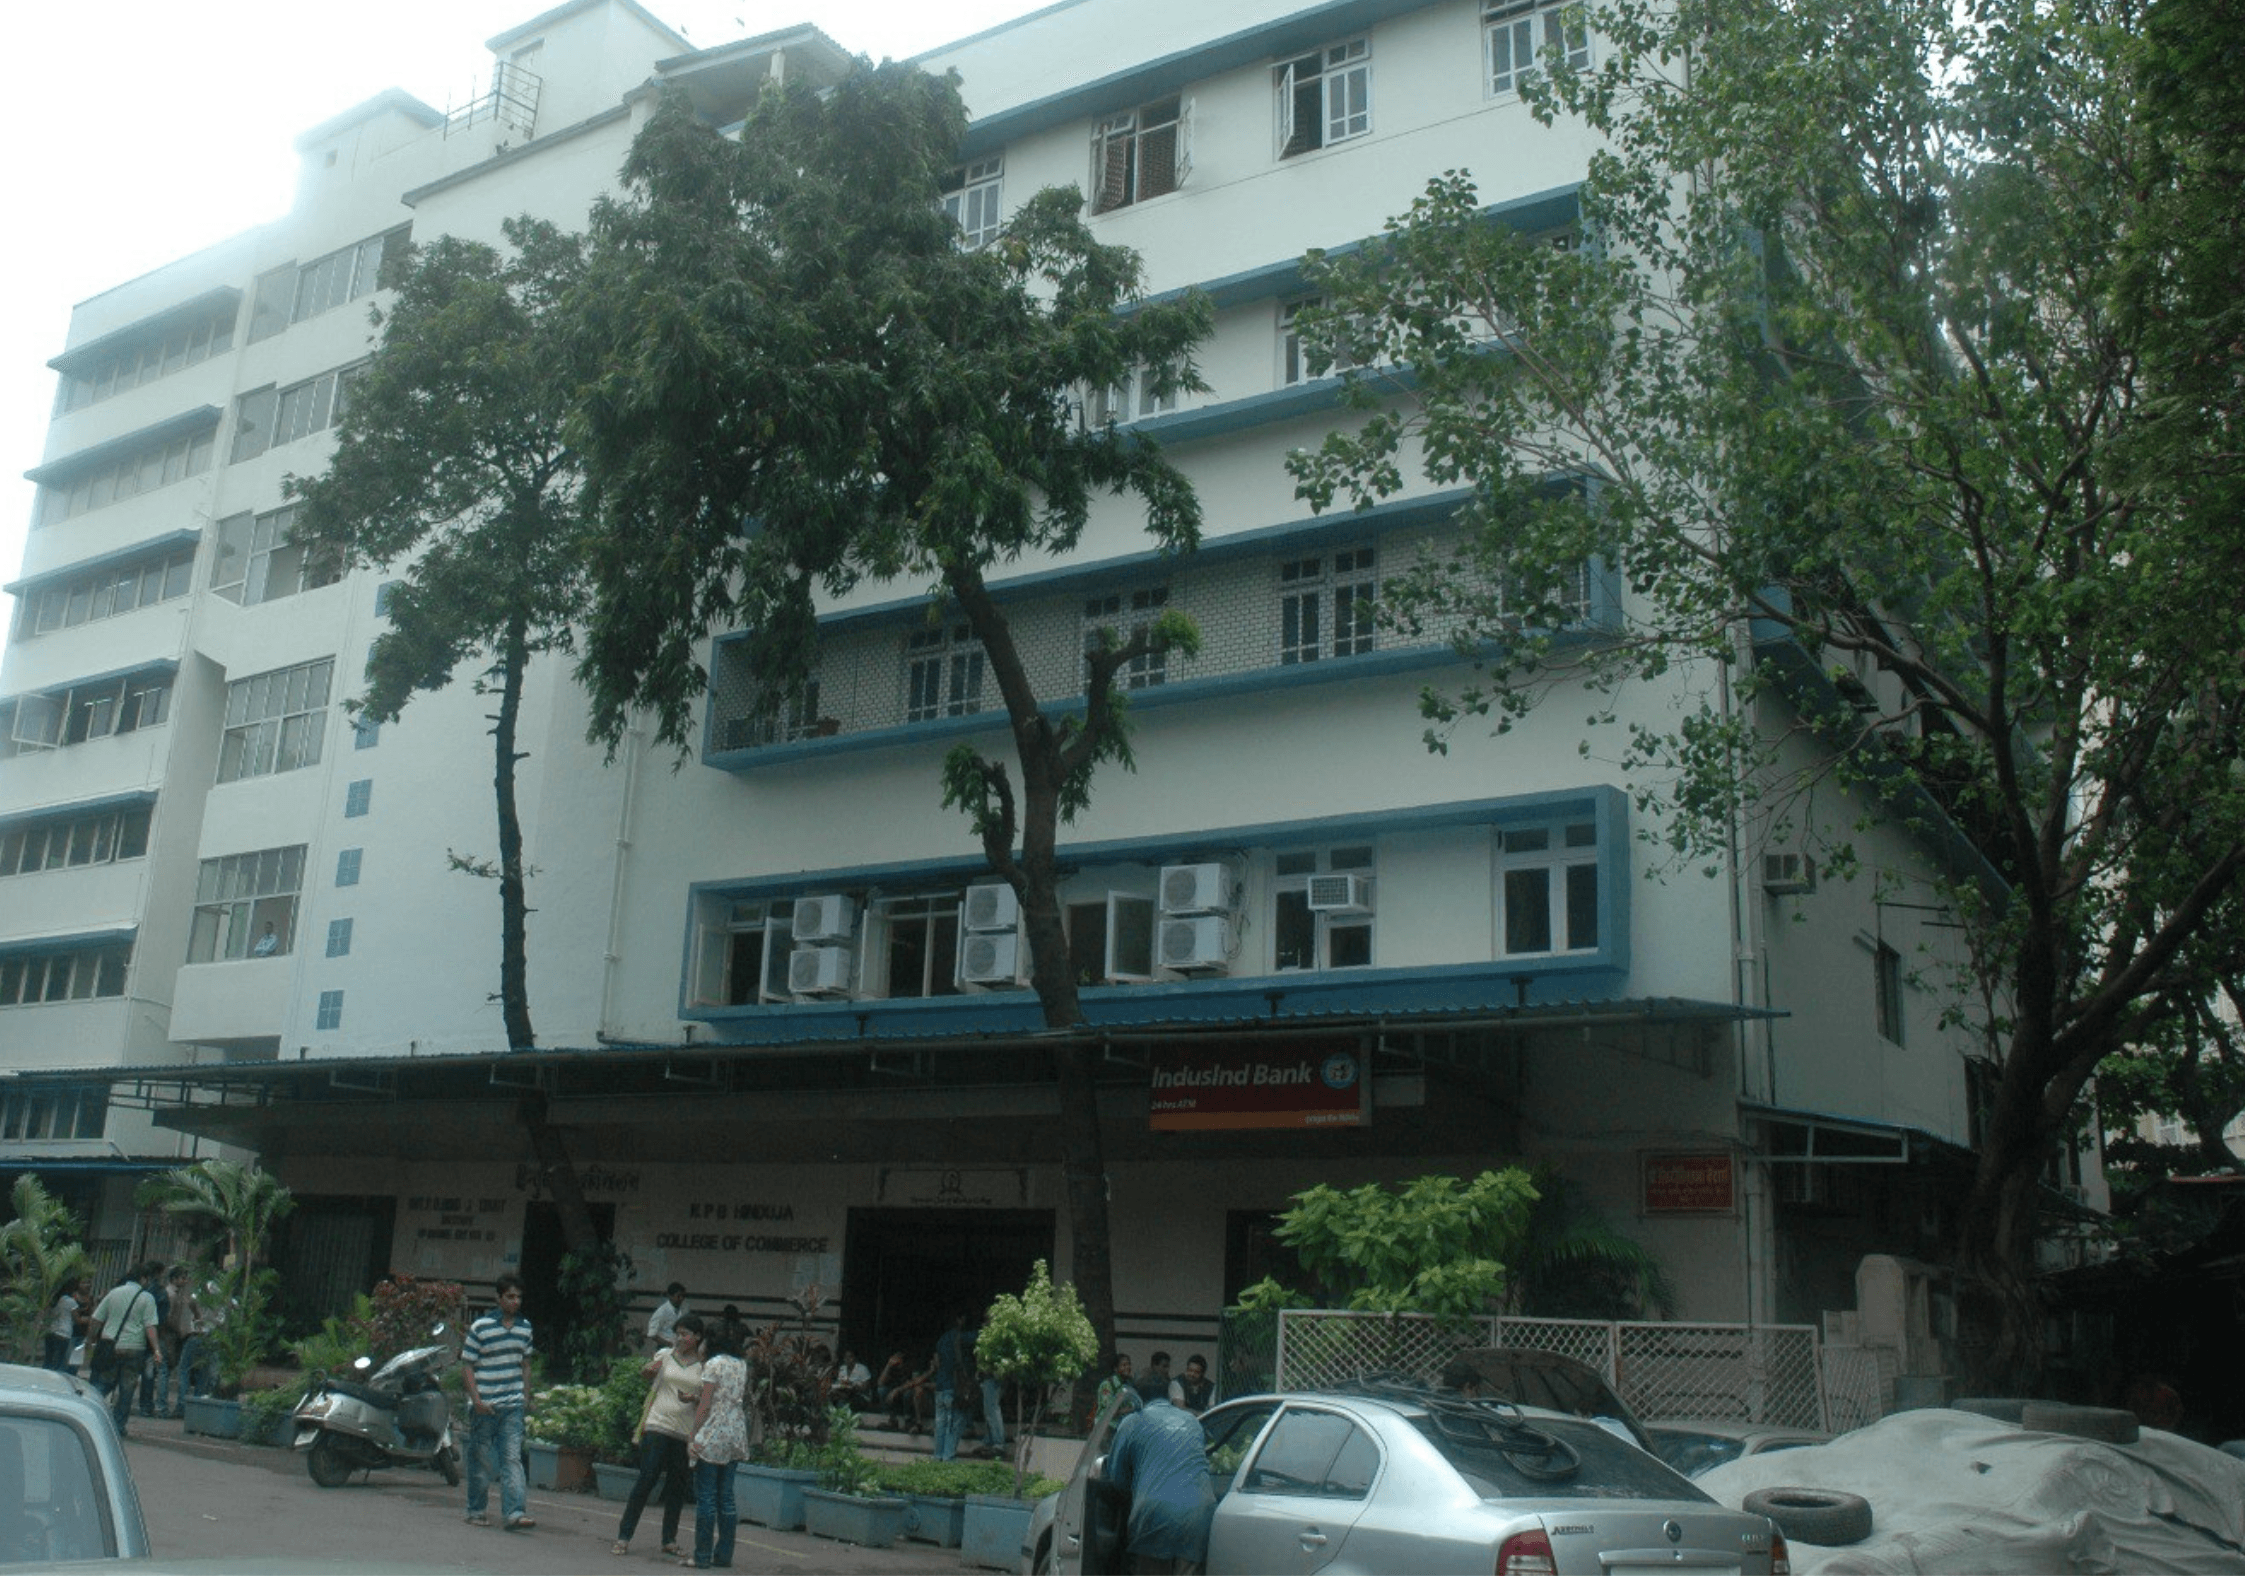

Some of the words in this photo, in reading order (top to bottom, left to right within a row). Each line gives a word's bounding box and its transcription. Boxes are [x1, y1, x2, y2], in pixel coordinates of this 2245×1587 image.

[1151, 1063, 1250, 1088] IndusInd
[1253, 1061, 1313, 1085] Bank
[656, 1232, 718, 1250] COLLEGE
[722, 1234, 742, 1251] OF
[745, 1236, 829, 1253] COMMERCE
